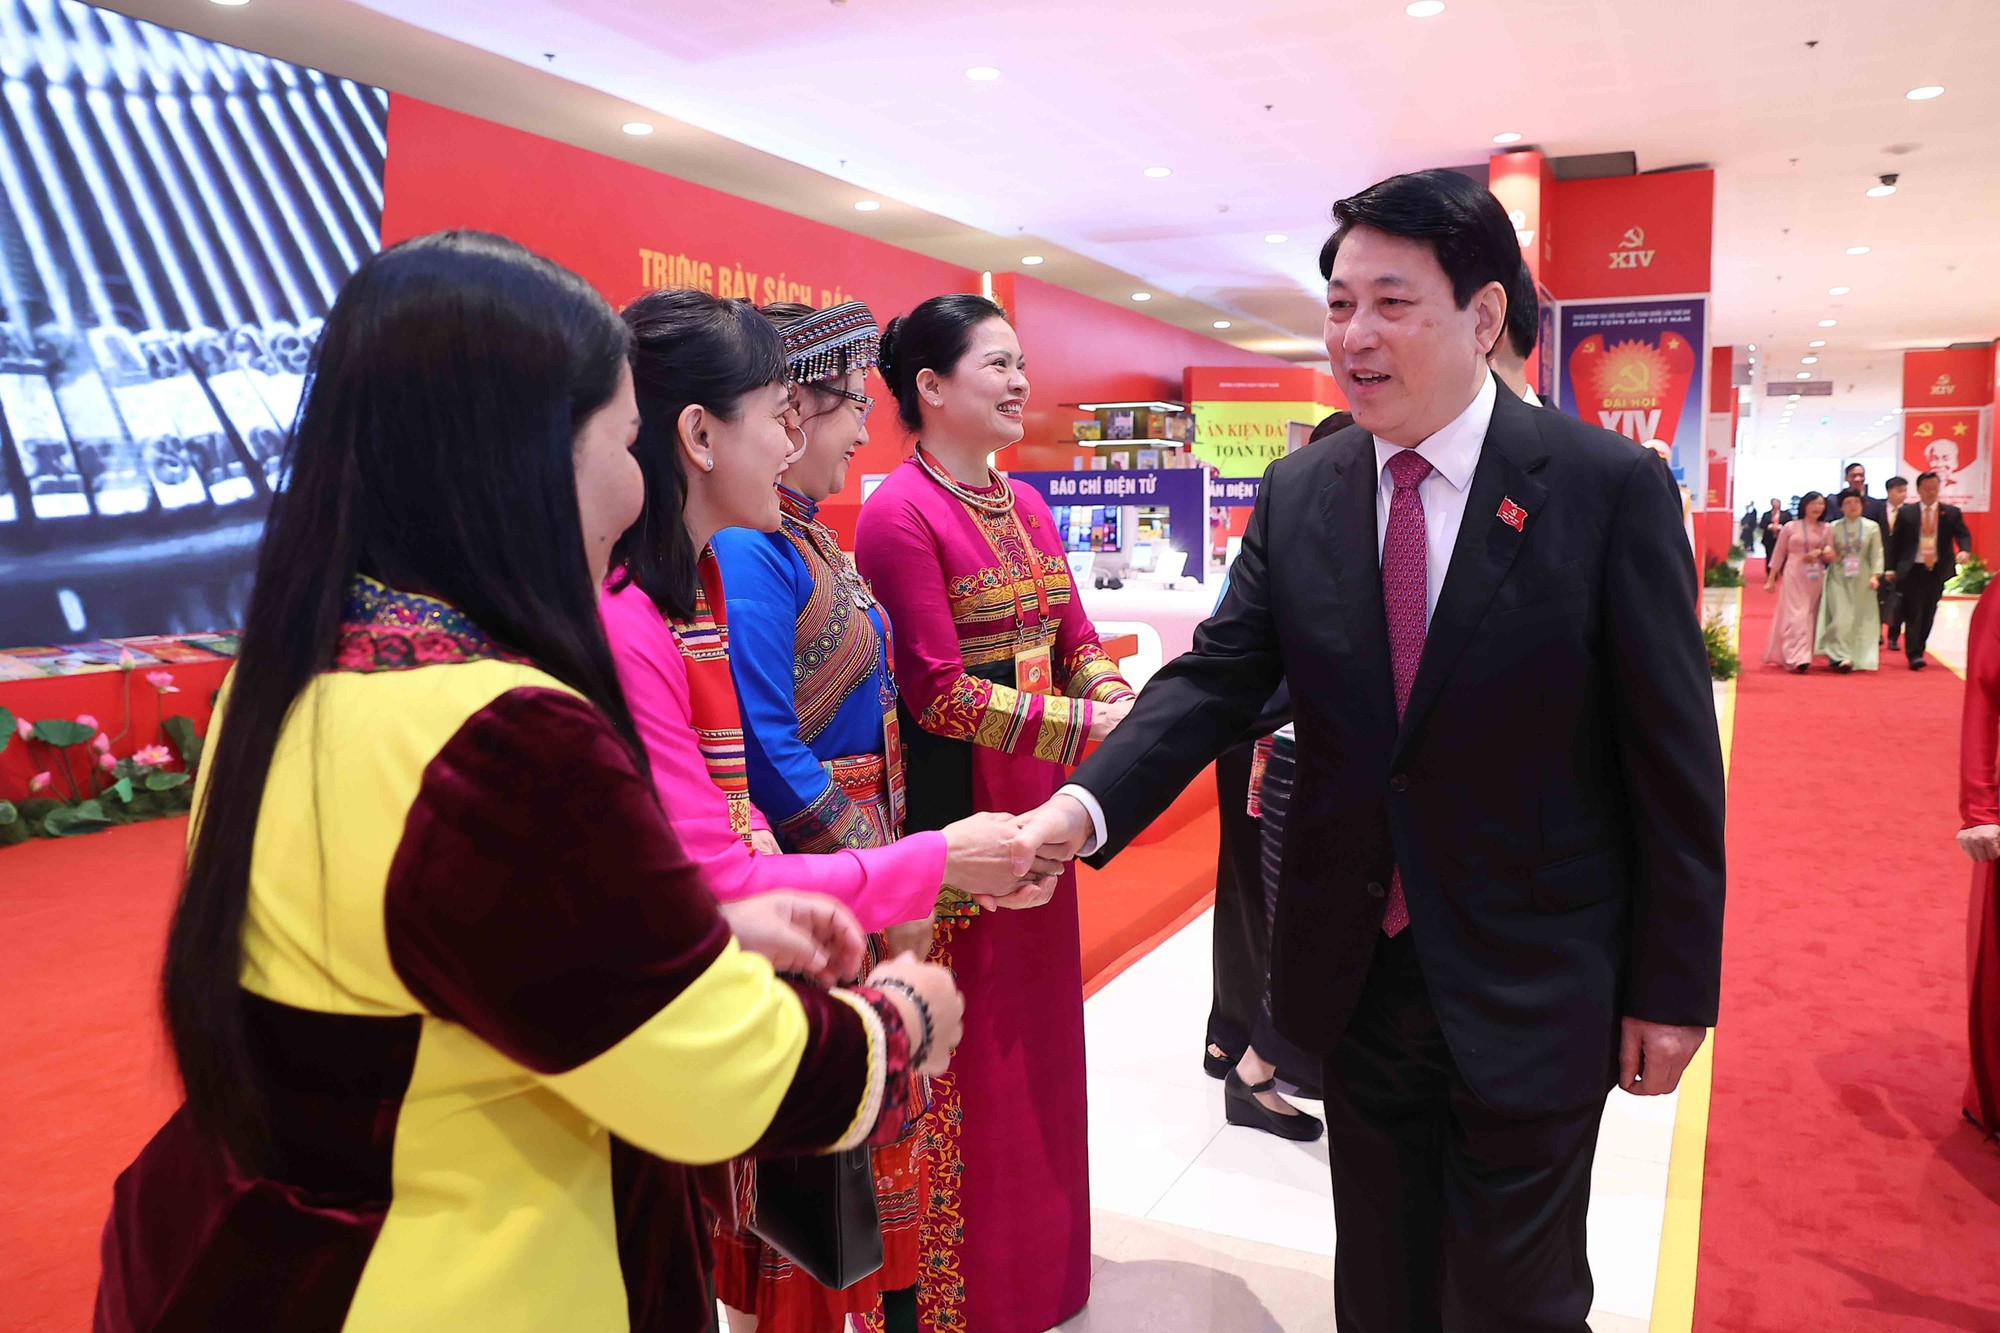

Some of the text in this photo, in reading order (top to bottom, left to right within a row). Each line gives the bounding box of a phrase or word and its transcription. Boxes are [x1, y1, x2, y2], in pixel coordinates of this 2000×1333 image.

[1608, 249, 1656, 269] XIV
[719, 262, 758, 304] BÀY
[763, 273, 812, 308] SÁCH
[1597, 408, 1662, 444] XIV
[1050, 473, 1157, 498] BÁO CHÍ ĐIỆN TỬ
[1226, 481, 1254, 500] ĐIỆN
